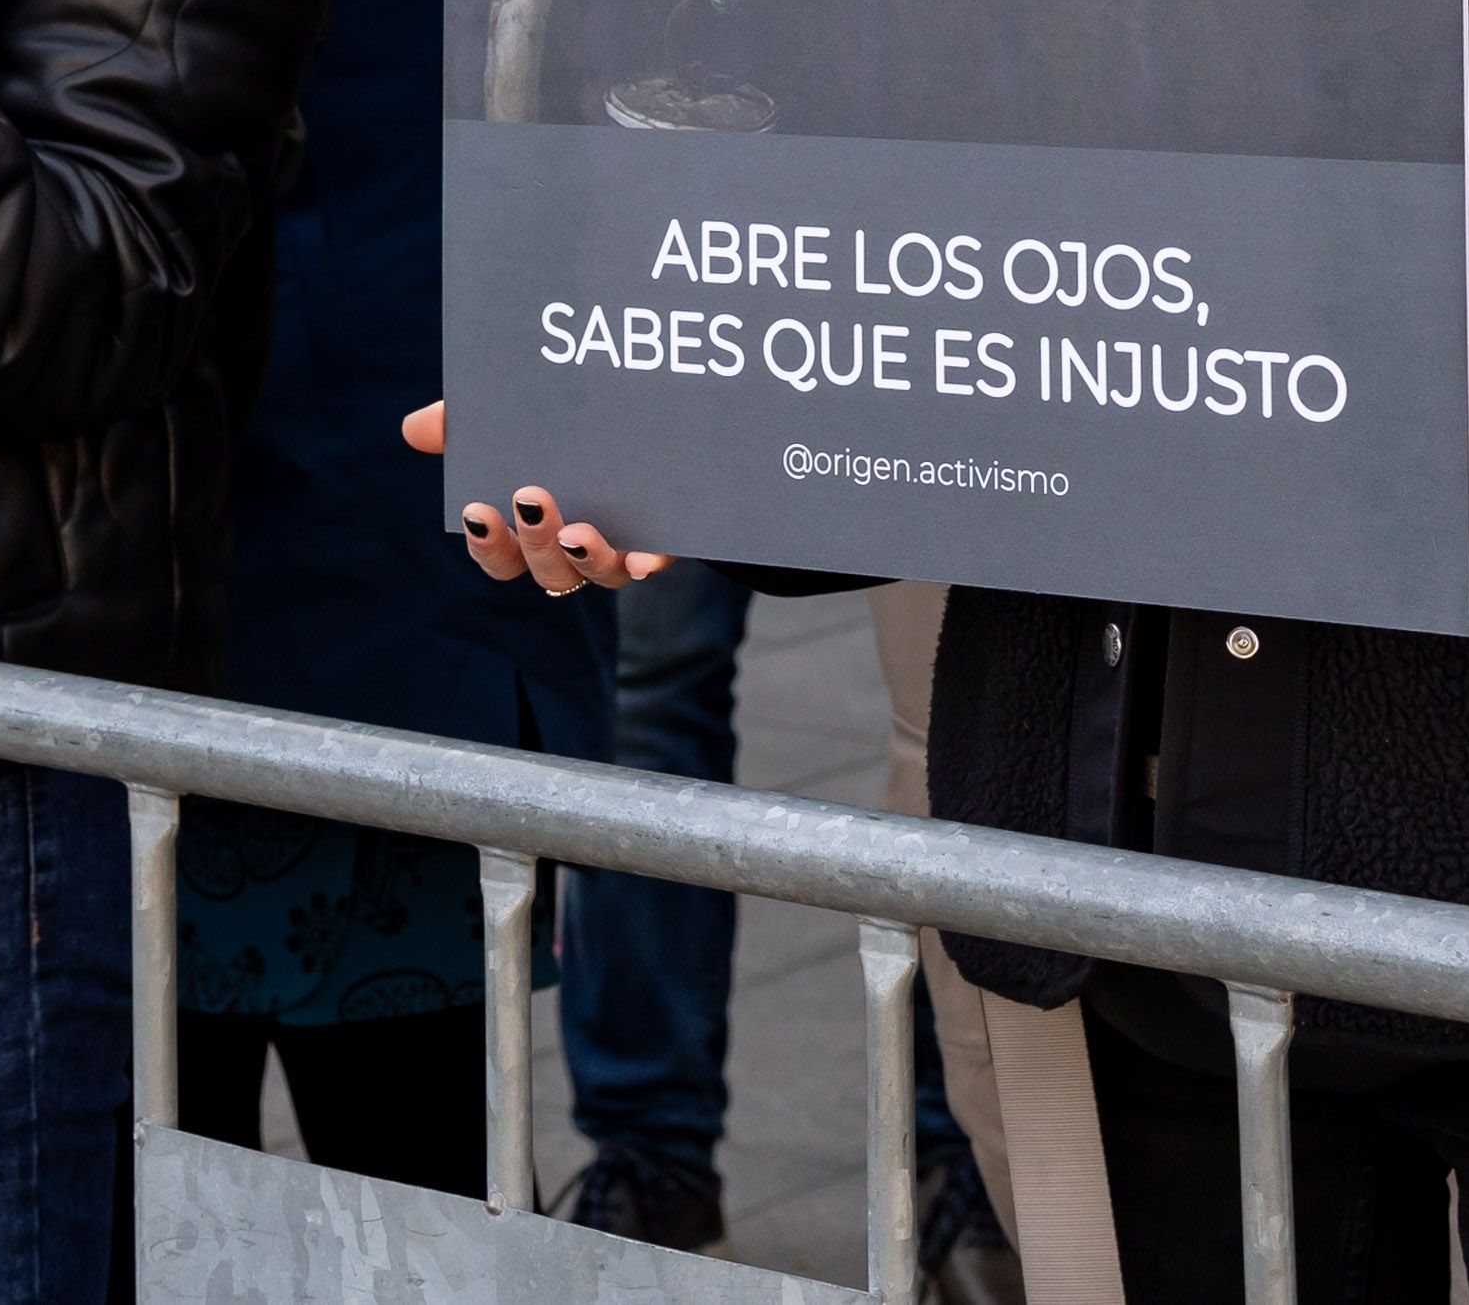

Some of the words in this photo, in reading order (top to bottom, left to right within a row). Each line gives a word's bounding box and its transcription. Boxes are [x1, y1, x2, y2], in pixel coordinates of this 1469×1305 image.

[651, 218, 831, 291] ABRE
[854, 230, 984, 301] LOS
[1003, 238, 1211, 327] OJOS,
[540, 301, 745, 380] SABES
[762, 317, 912, 393] QUE
[934, 328, 1016, 398] ES
[1039, 335, 1348, 424] INJUSTO
[783, 442, 1070, 498] @origen.activismo
